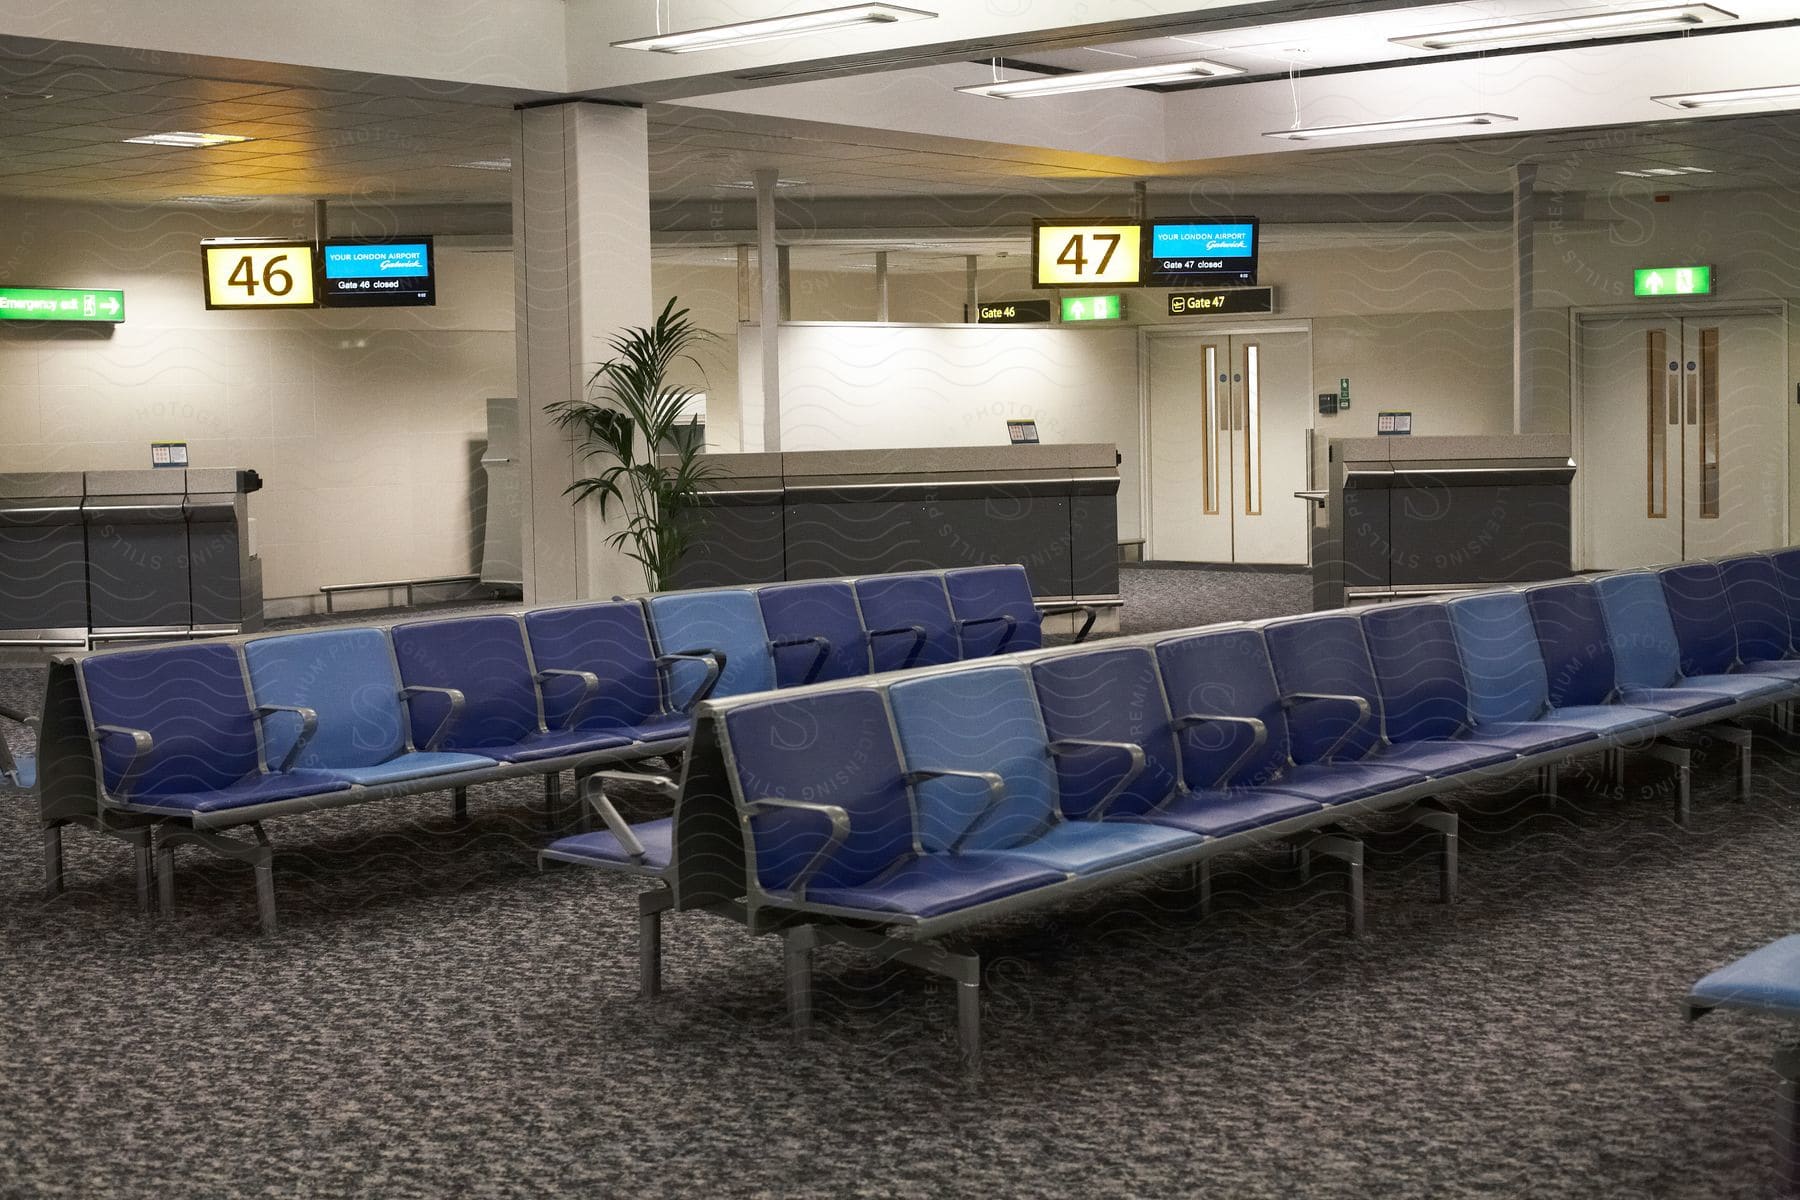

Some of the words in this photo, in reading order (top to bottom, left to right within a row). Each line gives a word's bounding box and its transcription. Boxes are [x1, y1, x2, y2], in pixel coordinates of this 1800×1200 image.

[1158, 233, 1179, 241] YOUR
[1180, 232, 1213, 240] LONDON
[330, 253, 351, 261] YOUR
[353, 252, 386, 261] LONDON
[388, 252, 421, 260] AIRPORT
[1056, 233, 1121, 275] 47
[1163, 260, 1183, 269] Gate
[1185, 260, 1195, 268] 47
[1197, 260, 1223, 268] closed
[227, 254, 294, 297] 46
[338, 280, 358, 289] Gate
[373, 280, 399, 288] closed
[1187, 297, 1211, 310] Gate
[1211, 295, 1225, 308] 47
[981, 308, 1003, 320] Gate
[1003, 306, 1016, 318] 46
